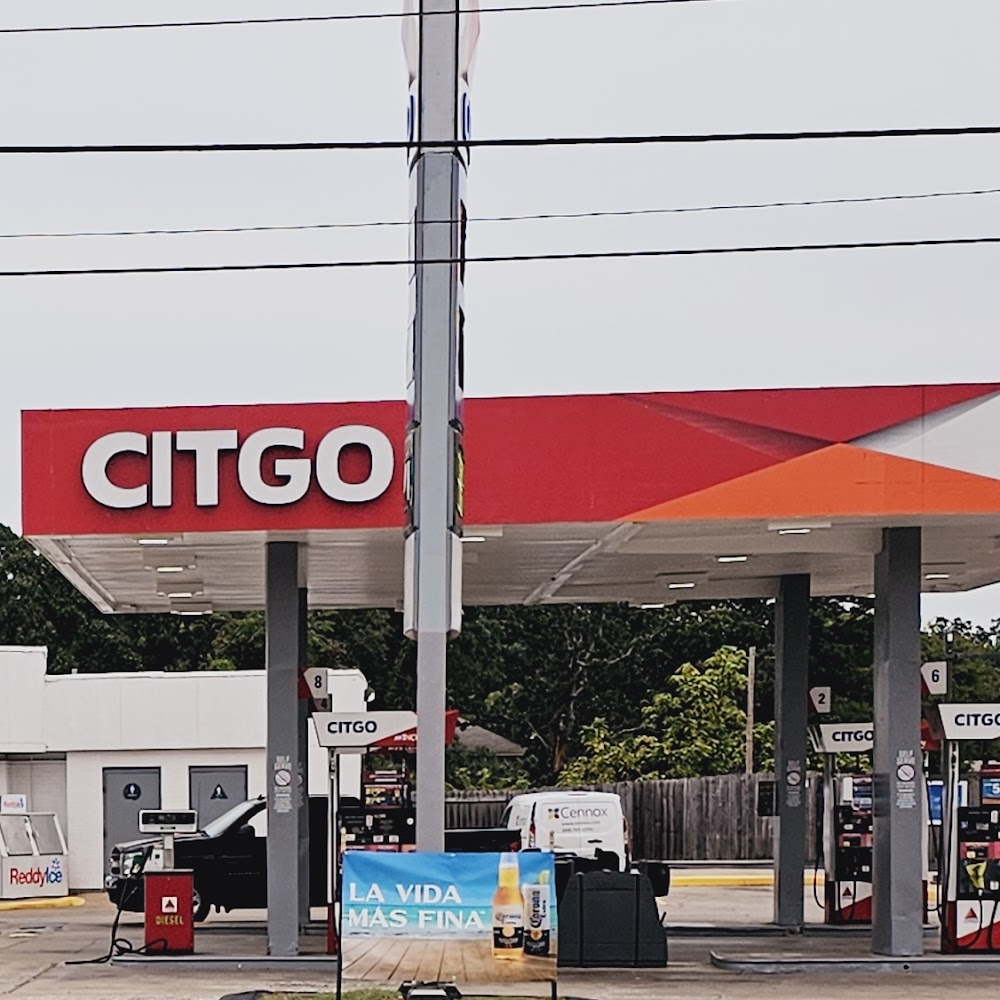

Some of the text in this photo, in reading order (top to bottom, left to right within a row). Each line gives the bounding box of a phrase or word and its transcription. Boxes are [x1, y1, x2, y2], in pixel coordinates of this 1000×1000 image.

[82, 424, 395, 508] CITGO
[314, 675, 322, 689] 8
[931, 669, 940, 683] 6
[818, 693, 826, 704] 2
[327, 721, 378, 733] CITGO
[560, 807, 608, 819] Cennox
[349, 883, 462, 904] LA VIDA
[155, 915, 185, 926] DIESEL
[348, 906, 408, 928] MÁS
